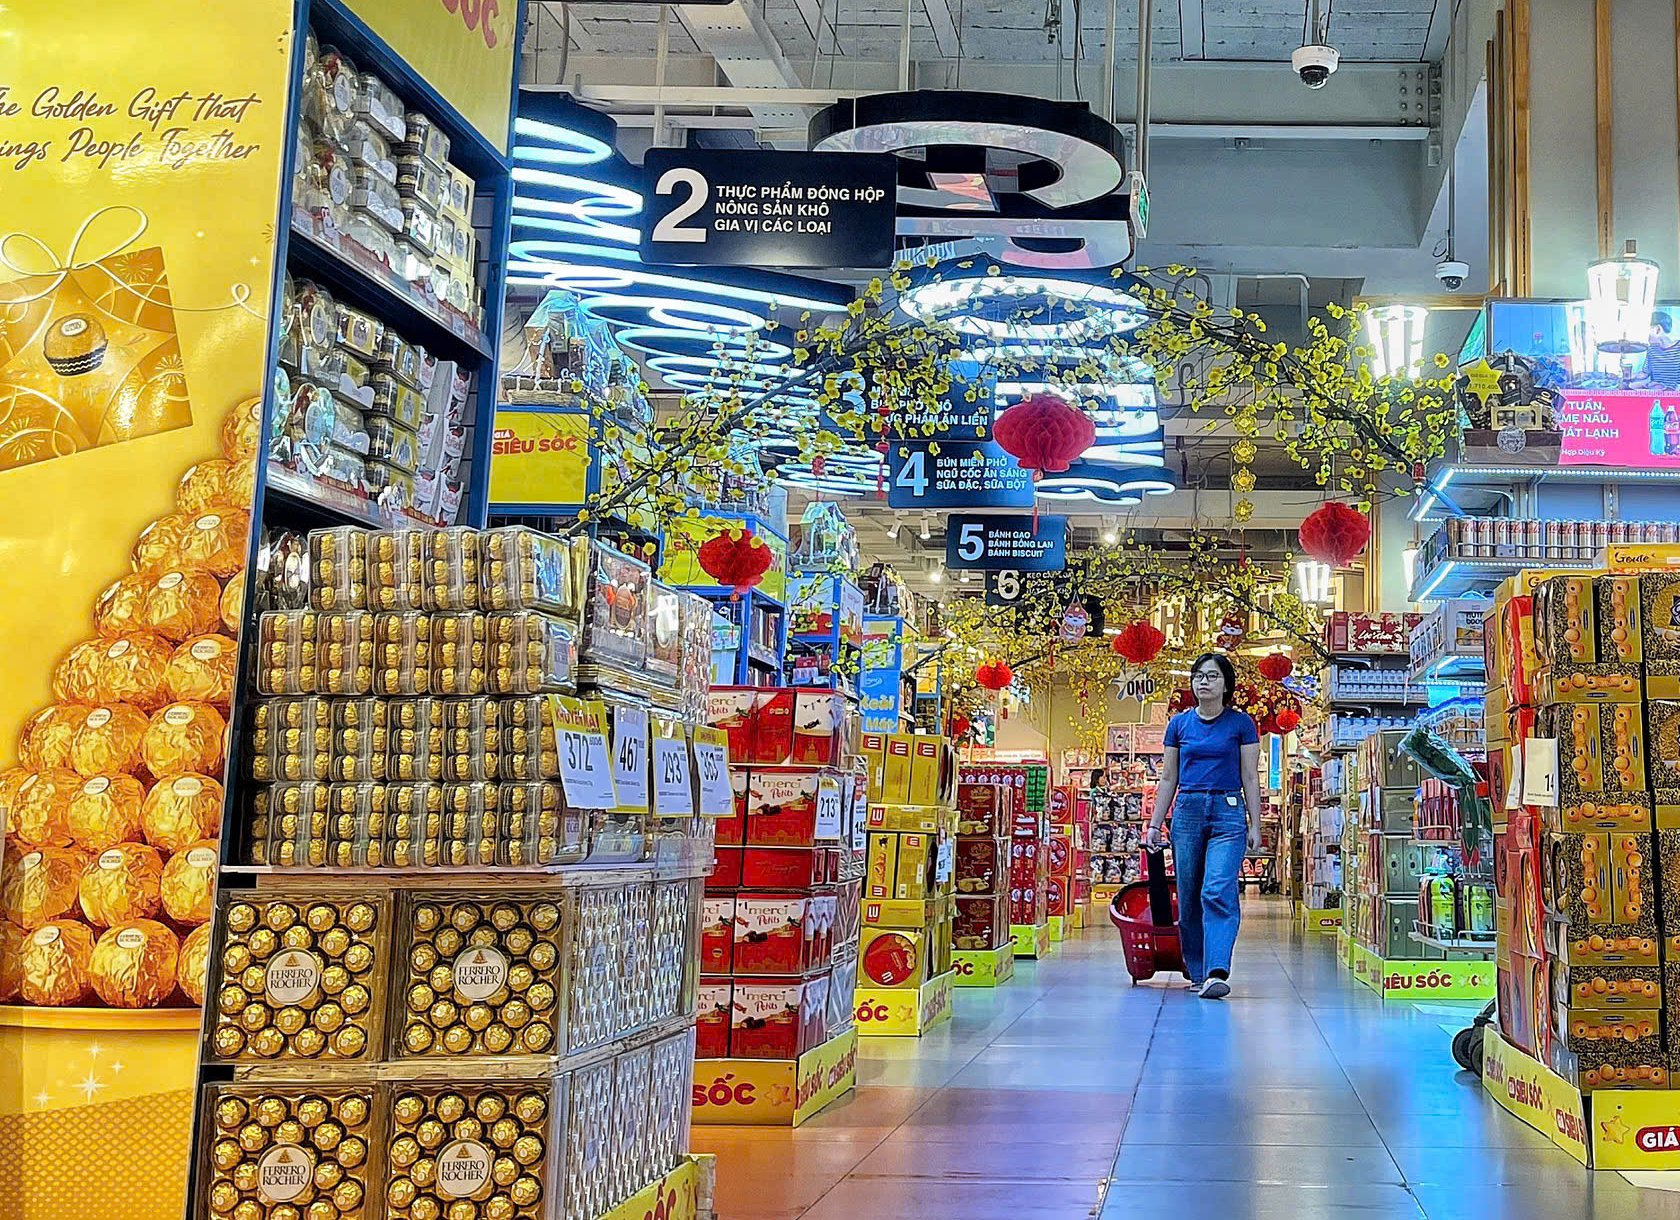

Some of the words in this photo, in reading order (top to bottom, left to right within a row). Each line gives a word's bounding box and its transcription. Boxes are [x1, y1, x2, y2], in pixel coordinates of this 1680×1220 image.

[0, 87, 21, 117] he
[31, 86, 118, 121] Golden
[128, 87, 192, 131] Gift
[192, 92, 262, 123] that
[0, 140, 51, 170] ings
[60, 127, 145, 169] People
[159, 128, 260, 170] Together
[715, 184, 757, 200] THỰC
[760, 181, 803, 200] PHẨM
[807, 186, 850, 201] ĐÓNG
[854, 186, 885, 204] HỘP
[651, 167, 709, 243] 2
[715, 200, 759, 216] NÔNG
[762, 200, 793, 216] SẢN
[797, 201, 830, 217] KHÔ
[714, 219, 740, 232] GIA
[744, 220, 759, 234] VỊ
[762, 217, 794, 233] CÁC
[797, 220, 832, 235] LOẠI
[825, 370, 866, 428] 3
[942, 412, 958, 425] ĂN
[961, 411, 988, 426] LIỀN
[1585, 427, 1619, 440] LẠNH
[493, 438, 535, 455] SIÊU
[538, 434, 577, 453] SỐC
[936, 456, 957, 468] BÚN
[896, 451, 929, 496] 4
[936, 468, 958, 479] NGŨ
[960, 467, 982, 478] CỐC
[983, 467, 997, 478] ĂN
[999, 467, 1028, 478] SÁNG
[936, 479, 957, 490] SỮA
[958, 479, 982, 491] ĐẶC,
[983, 479, 1005, 490] SỮA
[1006, 479, 1027, 491] BỘT
[988, 529, 1011, 539] BÁNH
[958, 523, 985, 561] 5
[988, 539, 1011, 548] BÁNH
[1037, 540, 1054, 549] LAN
[987, 548, 1010, 557] BÁNH
[1012, 549, 1044, 558] BISCUIT
[997, 569, 1020, 600] 6
[1126, 679, 1154, 696] OMO
[708, 696, 736, 706] erci
[564, 732, 594, 771] 372
[619, 735, 638, 773] 467
[662, 751, 683, 785] 293
[762, 778, 802, 788] merci
[770, 788, 794, 799] Petits
[820, 796, 836, 818] 213
[872, 808, 883, 821] LU
[748, 905, 788, 915] merci
[868, 905, 879, 918] LU
[757, 914, 780, 926] Petits
[270, 968, 313, 979] FERRERO
[459, 965, 501, 976] FERRERO
[950, 958, 974, 976] ỐC
[270, 978, 312, 989] ROCHER
[458, 975, 500, 985] ROCHER
[1415, 969, 1452, 988] SỐC
[746, 990, 786, 1001] merci
[754, 1000, 778, 1012] Petits
[1642, 1127, 1679, 1148] GIÁ
[263, 1164, 306, 1176] FERRERO
[442, 1160, 485, 1171] FERRERO
[262, 1175, 305, 1186] ROCHER
[441, 1170, 484, 1181] ROCHER
